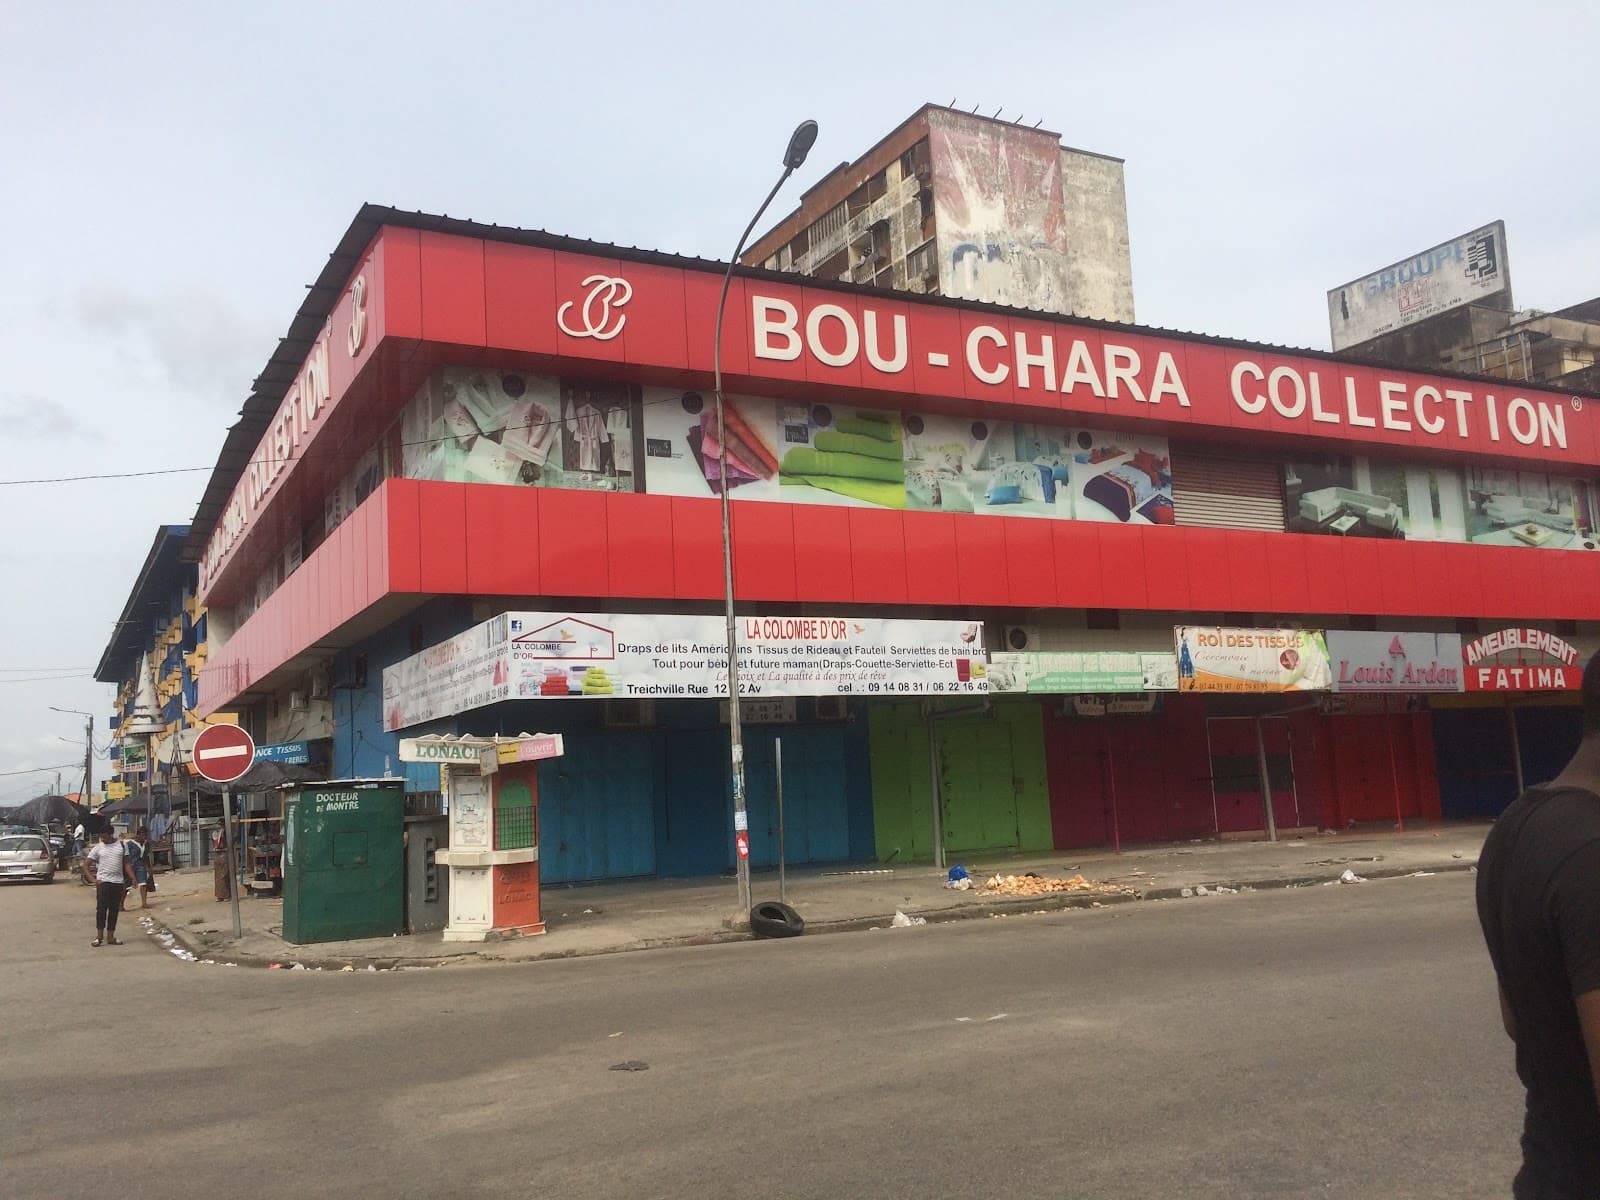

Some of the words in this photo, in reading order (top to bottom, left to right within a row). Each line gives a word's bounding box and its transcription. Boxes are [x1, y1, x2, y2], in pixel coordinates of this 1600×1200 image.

[1364, 240, 1464, 299] GROUPE
[752, 295, 907, 373] BOU
[965, 325, 1191, 408] CHARA
[1230, 361, 1567, 449] COLLECTION
[746, 619, 761, 640] LA
[763, 619, 817, 640] COLOMBE
[820, 620, 847, 641] D'OR
[524, 643, 561, 651] COLOMBE
[1226, 634, 1253, 648] DES
[1255, 635, 1304, 648] TISSUS
[1466, 628, 1578, 666] AMEUBLEMENT
[617, 643, 652, 654] Draps
[654, 643, 668, 653] de
[671, 643, 688, 654] lits
[691, 643, 753, 654] Américins
[757, 645, 788, 655] Tissus
[791, 645, 805, 655] de
[806, 645, 841, 655] Rideau
[843, 646, 853, 655] et
[890, 646, 936, 656] Serviettes
[938, 646, 950, 656] de
[951, 646, 970, 656] bain
[652, 658, 676, 669] Tout
[679, 660, 705, 671] pour
[707, 659, 729, 669] béb
[737, 659, 747, 669] et
[750, 659, 780, 669] future
[823, 670, 837, 681] des
[858, 670, 867, 680] de
[1338, 661, 1394, 684] Louis
[1400, 661, 1458, 684] Arden
[1478, 668, 1566, 688] FATIMA
[626, 683, 685, 695] Treichville
[687, 683, 709, 694] Rue
[714, 683, 727, 693] 12
[748, 683, 762, 693] Av
[837, 682, 852, 692] cel
[868, 683, 880, 692] 09
[883, 683, 895, 692] 14
[898, 683, 910, 692] 08
[912, 683, 924, 692] 31
[932, 683, 944, 692] 06
[948, 683, 960, 692] 22
[963, 683, 974, 692] 16
[977, 683, 988, 692] 49
[276, 744, 302, 754] TISSUS
[316, 791, 359, 803] DOCTEUR
[326, 801, 360, 811] MONTRE
